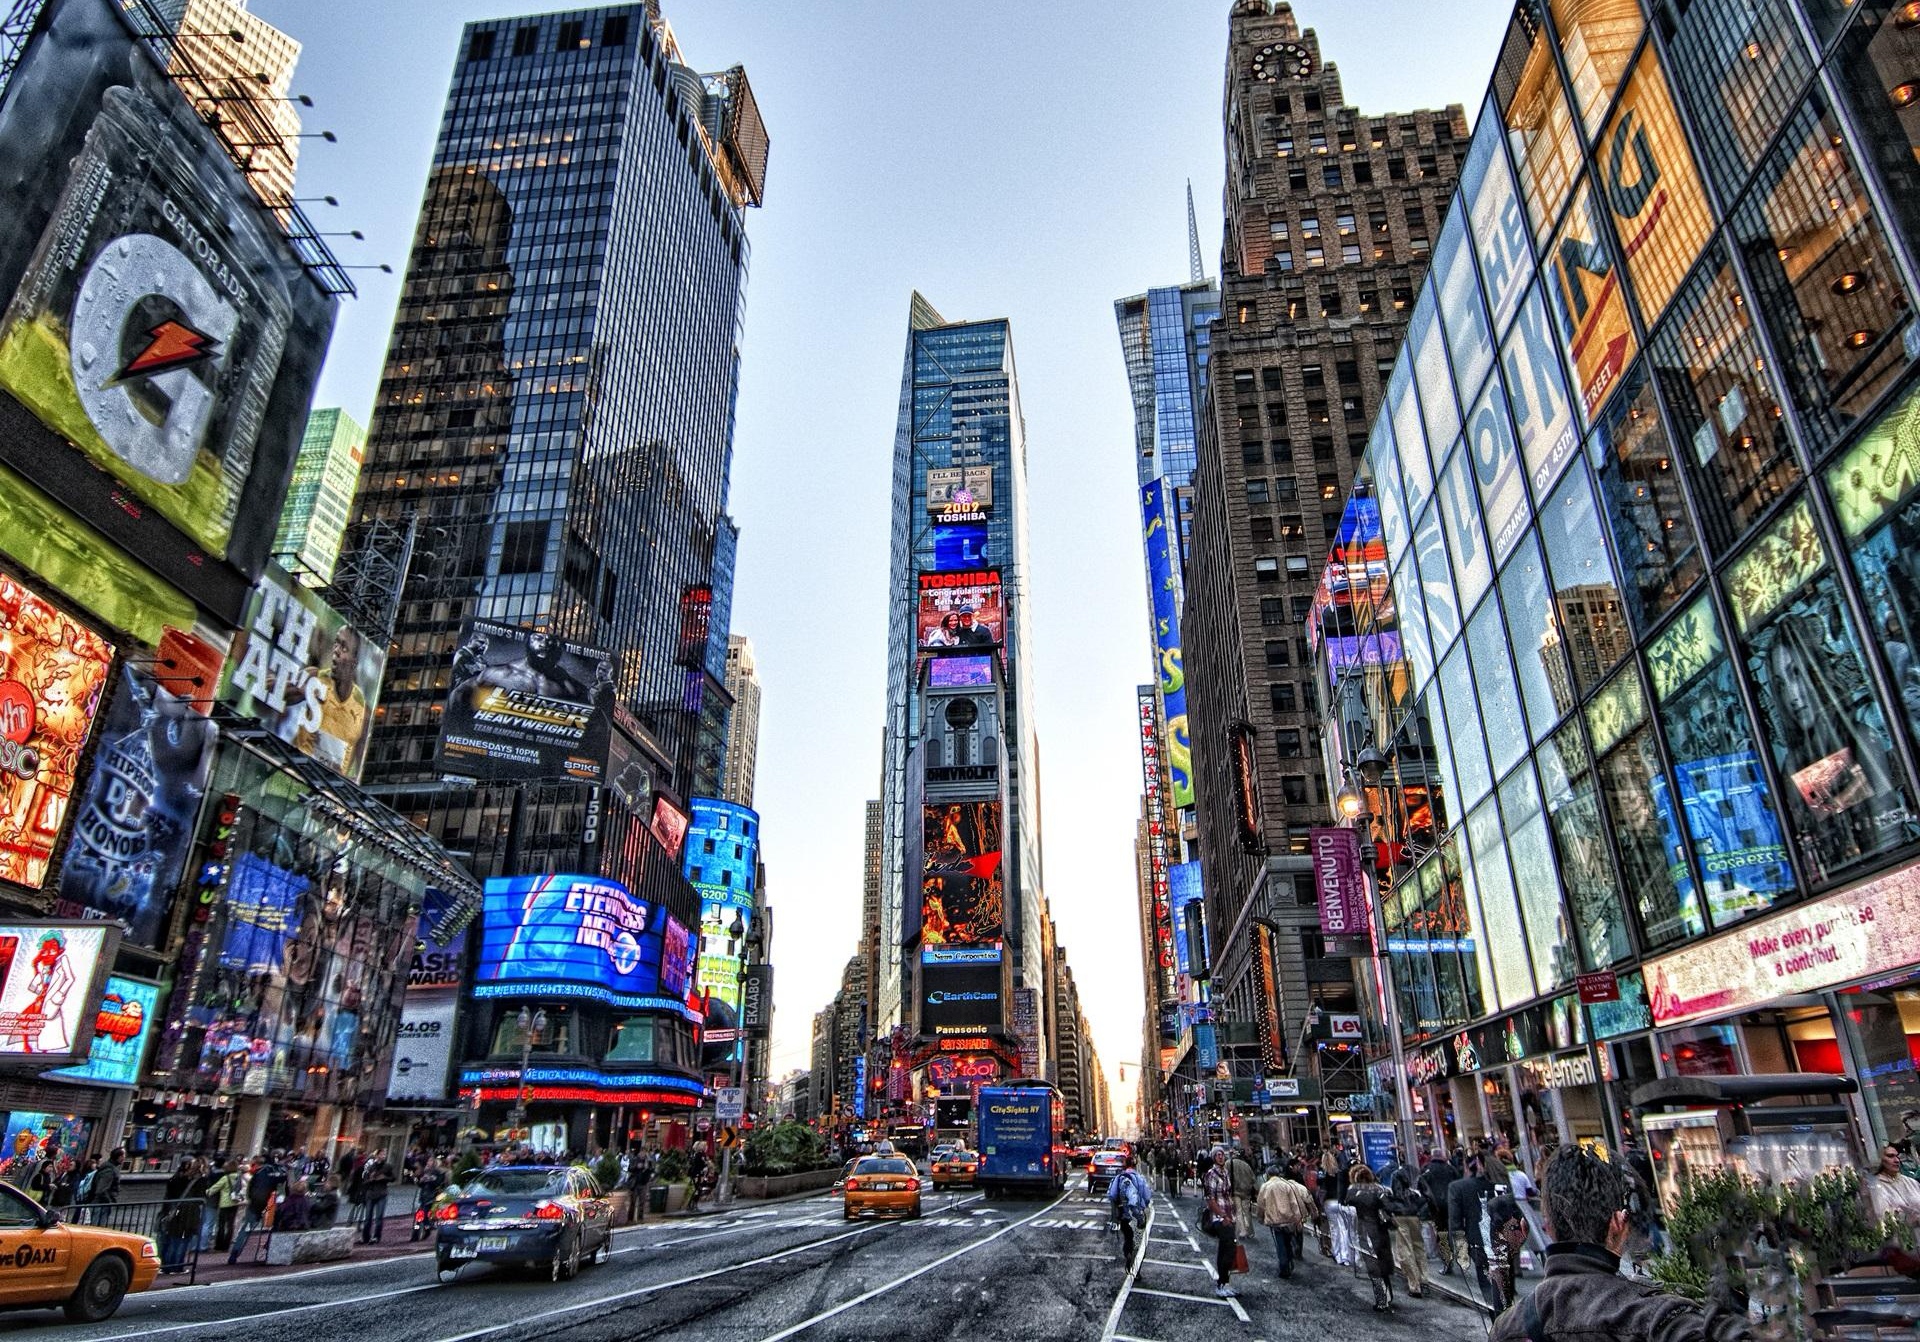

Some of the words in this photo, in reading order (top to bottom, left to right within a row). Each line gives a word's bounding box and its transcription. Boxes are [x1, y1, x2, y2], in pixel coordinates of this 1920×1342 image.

[161, 199, 250, 307] GATORADE
[1496, 497, 1530, 554] ENTRANCE
[1535, 465, 1551, 491] ON
[1551, 426, 1575, 469] 45TH
[936, 511, 987, 523] TOSHIBA
[943, 501, 980, 514] 2009
[919, 571, 1001, 589] TOSHIBA
[929, 586, 992, 598] Congratulations
[934, 597, 954, 607] Beth
[961, 596, 986, 606] Justin
[473, 621, 513, 639] KIMBO'S
[514, 631, 526, 642] IN
[564, 642, 582, 655] THE
[582, 647, 612, 662] HOUSE
[492, 686, 595, 716] ULTIMATE
[480, 697, 591, 730] FIGHTER
[473, 709, 586, 739] HEAVYWEIGHTS
[446, 734, 513, 754] WEDNESDAYS
[514, 747, 540, 758] 10PM
[487, 750, 532, 764] SEPTEMBER
[563, 761, 601, 773] SPIKE
[583, 785, 599, 845] 1500
[1317, 835, 1346, 931] BENVENUTO
[1749, 936, 1780, 960] Make
[1781, 927, 1813, 949] every
[1775, 962, 1784, 977] a
[943, 990, 998, 1002] EarthCam
[1584, 983, 1613, 992] ANYTIME
[746, 977, 760, 1025] EKAABO
[935, 1025, 988, 1035] Panasonic
[1202, 1048, 1210, 1068] UNO
[990, 1105, 1029, 1116] CitySights
[1029, 1105, 1040, 1114] NY
[16, 1244, 57, 1267] TAXI
